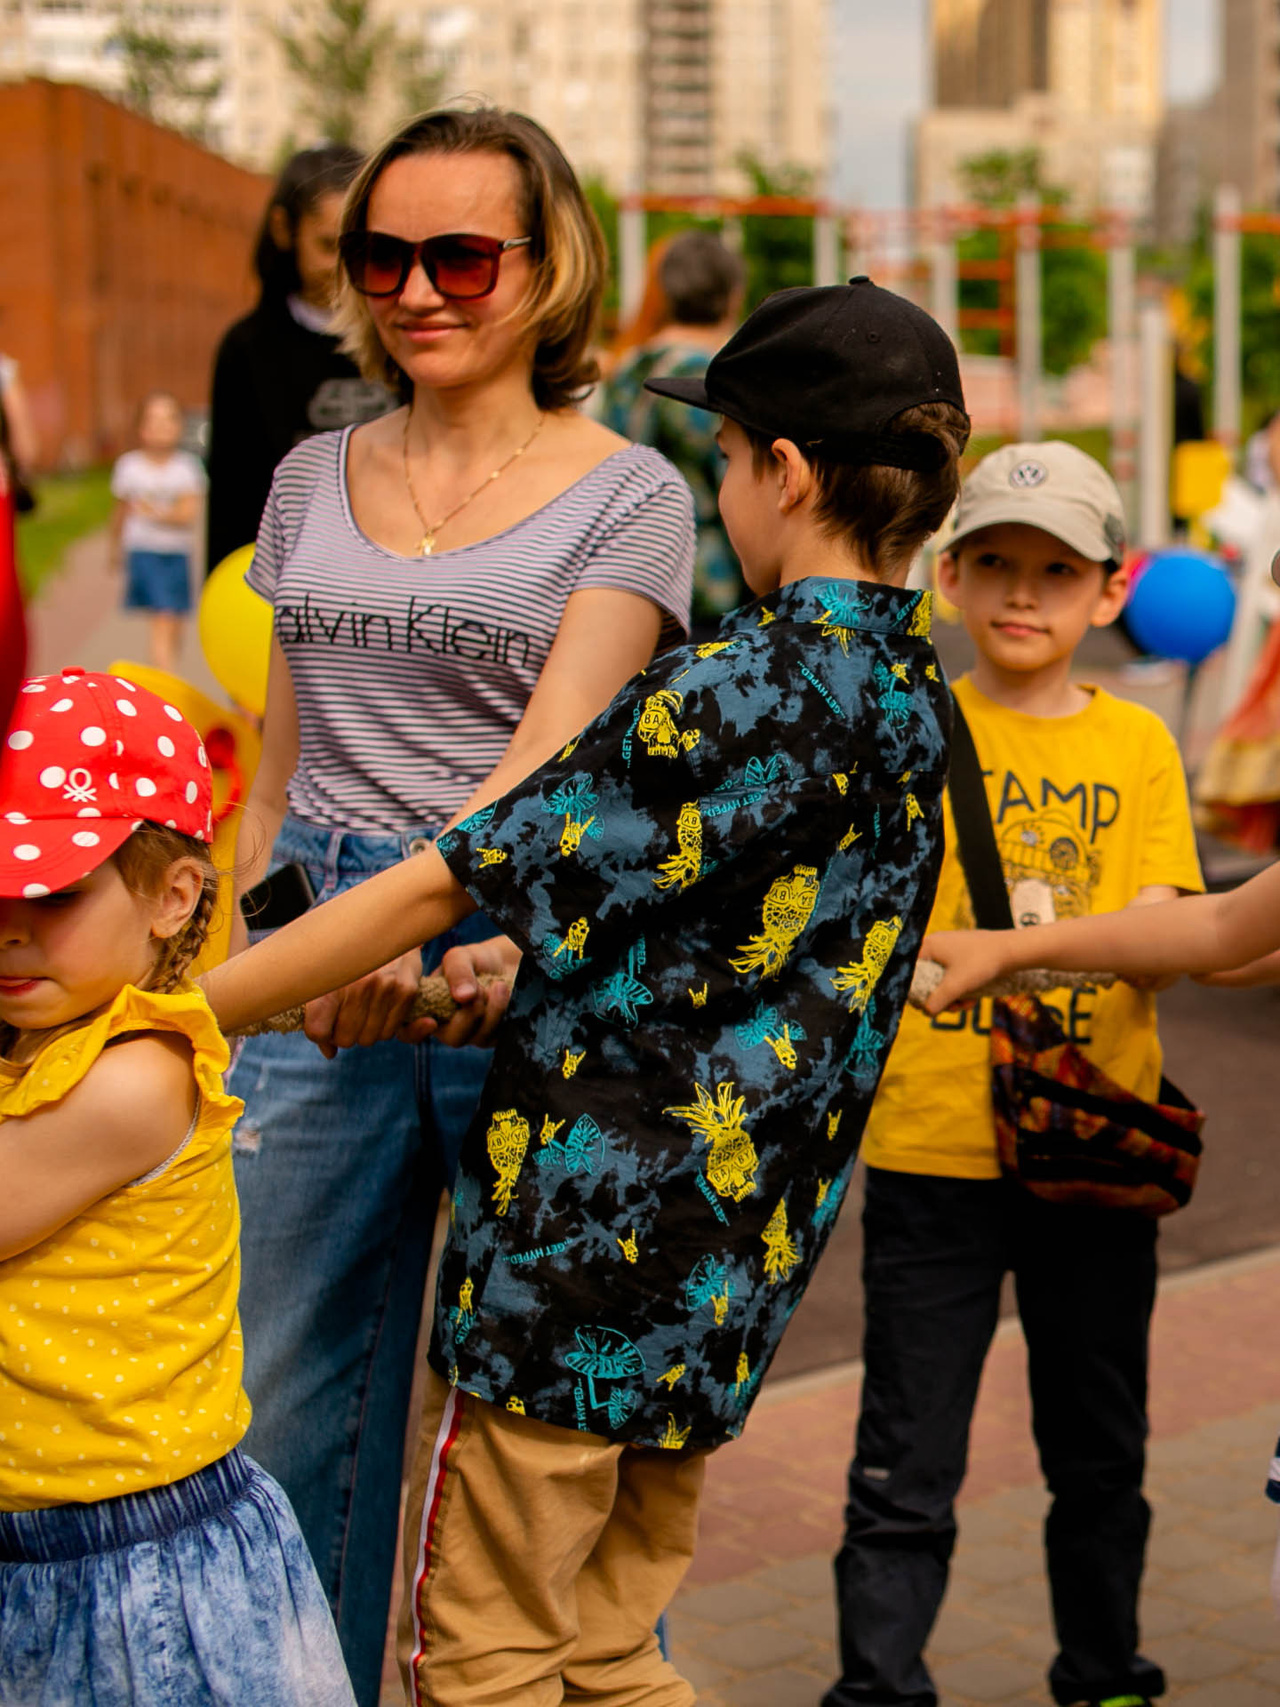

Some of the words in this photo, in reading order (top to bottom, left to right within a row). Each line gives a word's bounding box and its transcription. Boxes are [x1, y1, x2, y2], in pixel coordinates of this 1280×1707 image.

[276, 591, 393, 650] alvin
[406, 595, 530, 668] Klein
[981, 769, 1120, 845] AMP
